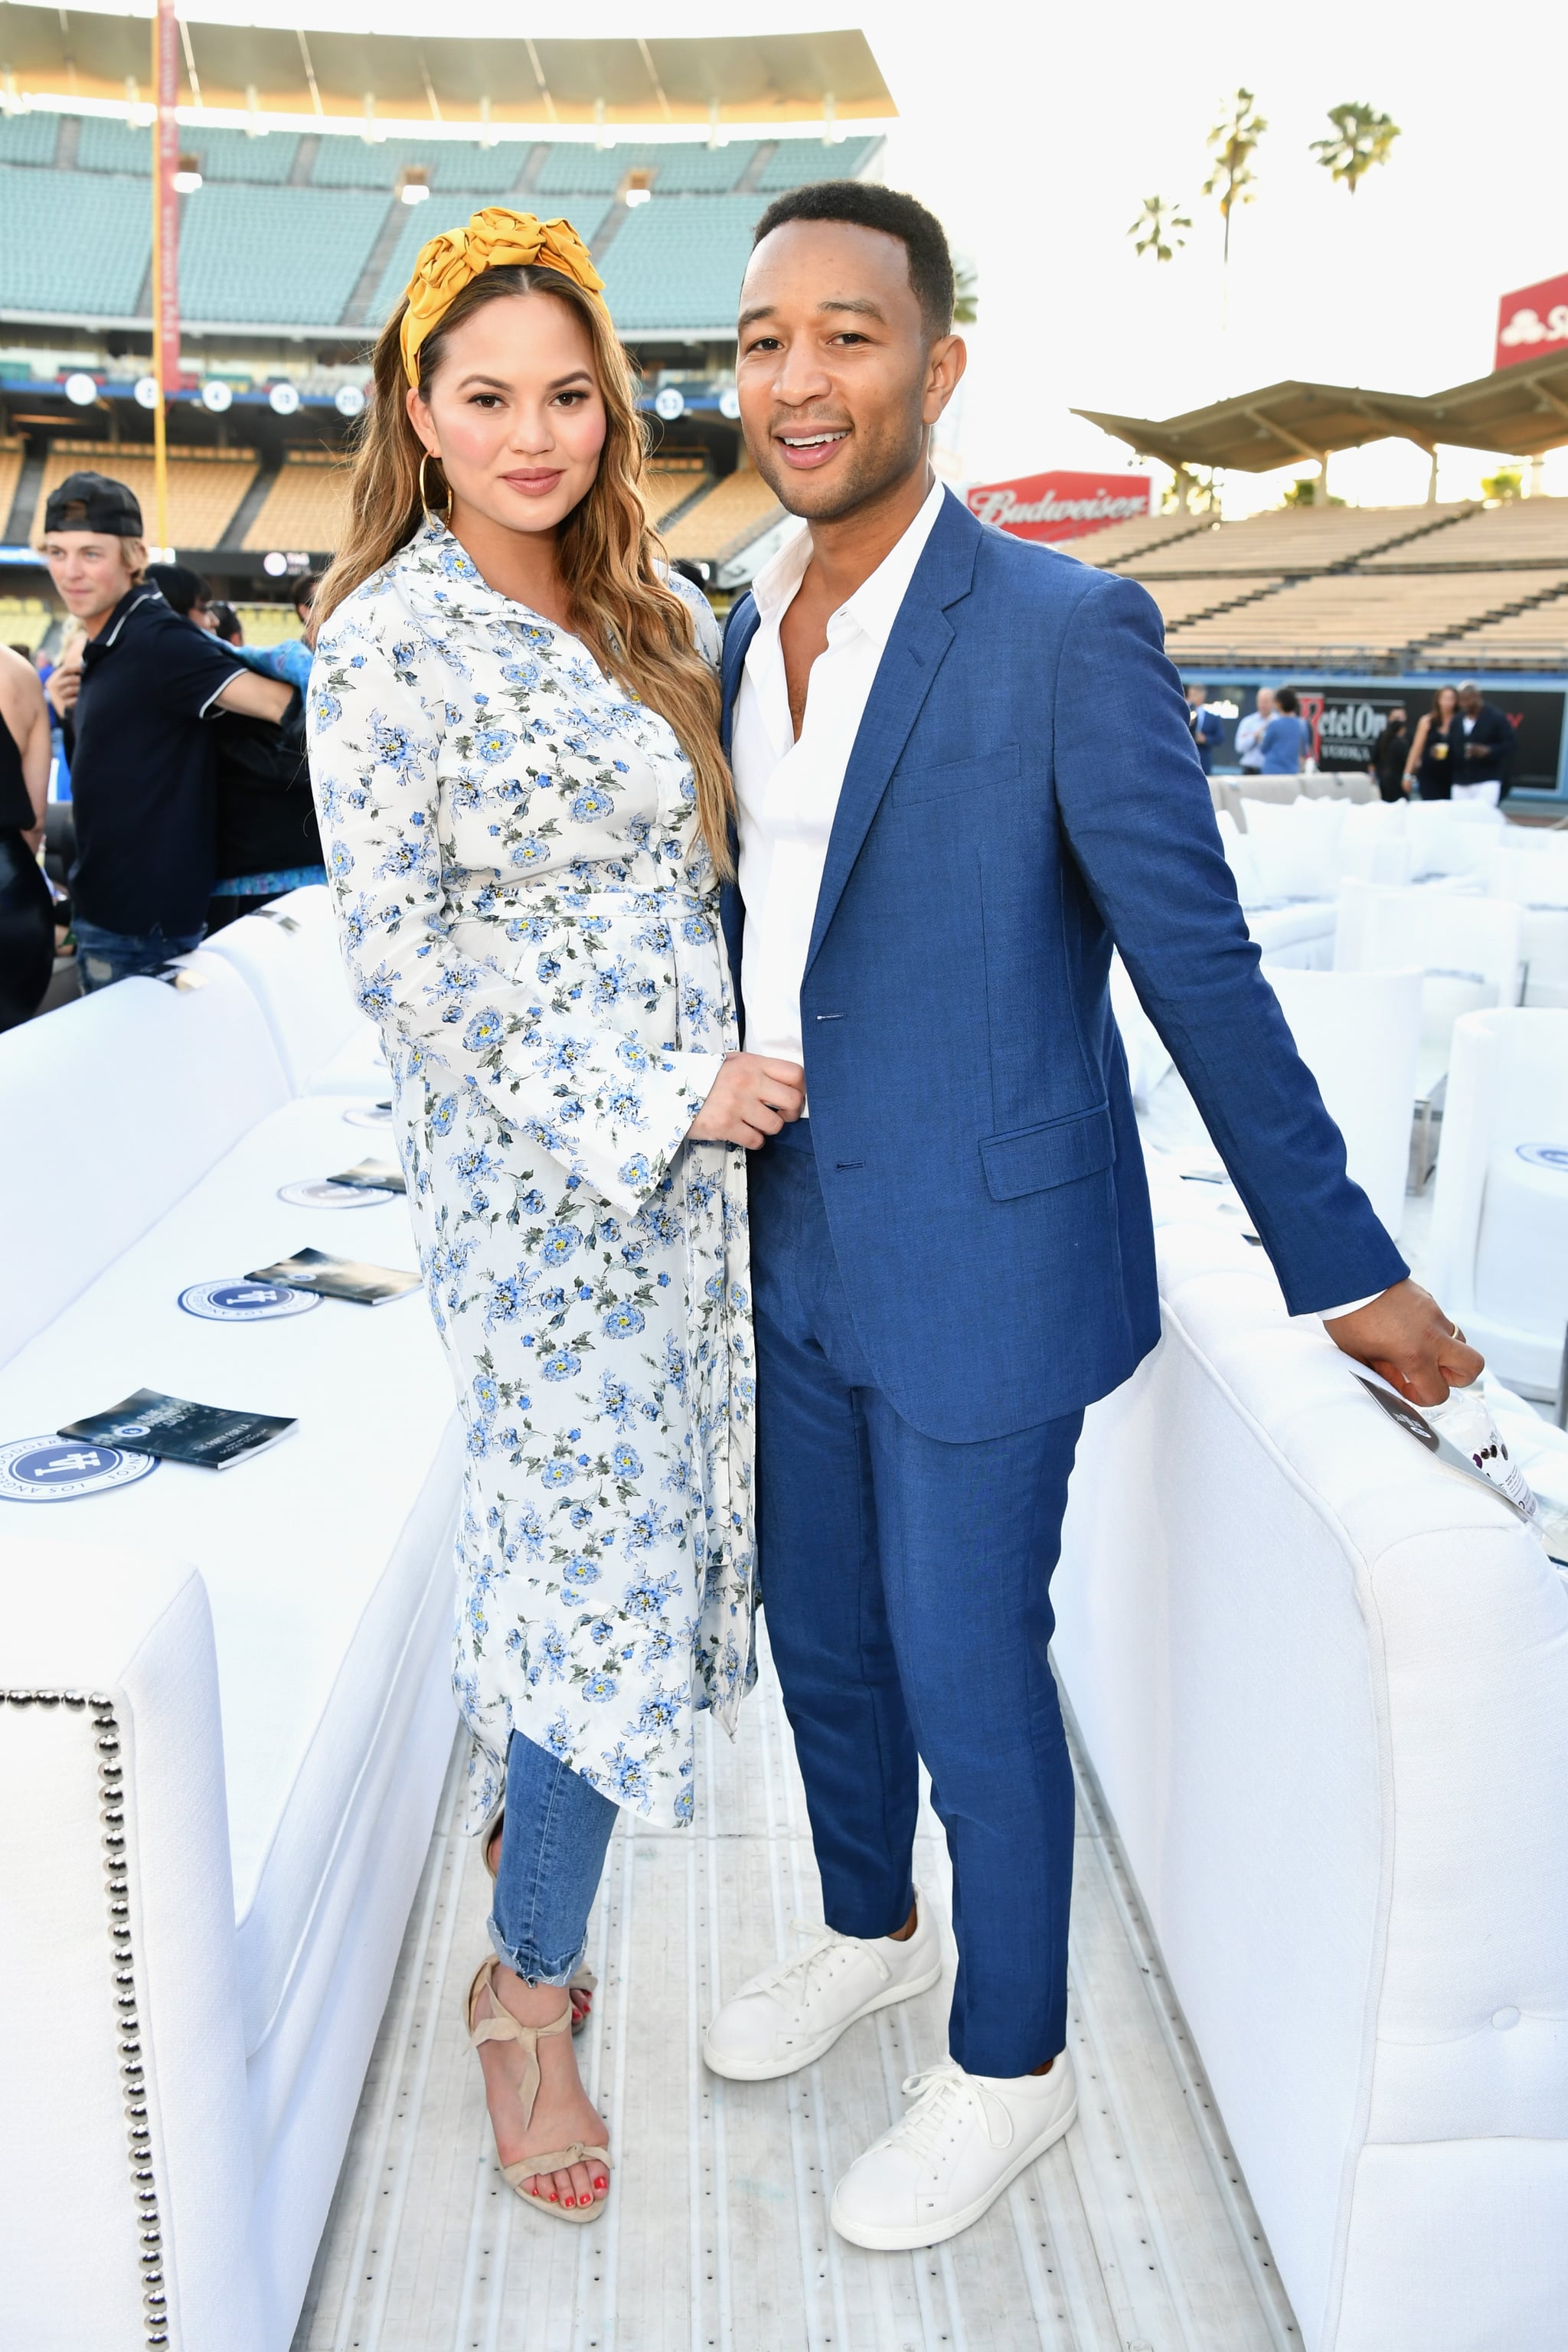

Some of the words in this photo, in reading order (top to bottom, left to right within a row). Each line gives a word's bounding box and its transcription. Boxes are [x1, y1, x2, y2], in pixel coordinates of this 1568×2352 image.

[1547, 304, 1568, 342] S
[969, 488, 1147, 527] Budweiser
[1354, 702, 1387, 741] On
